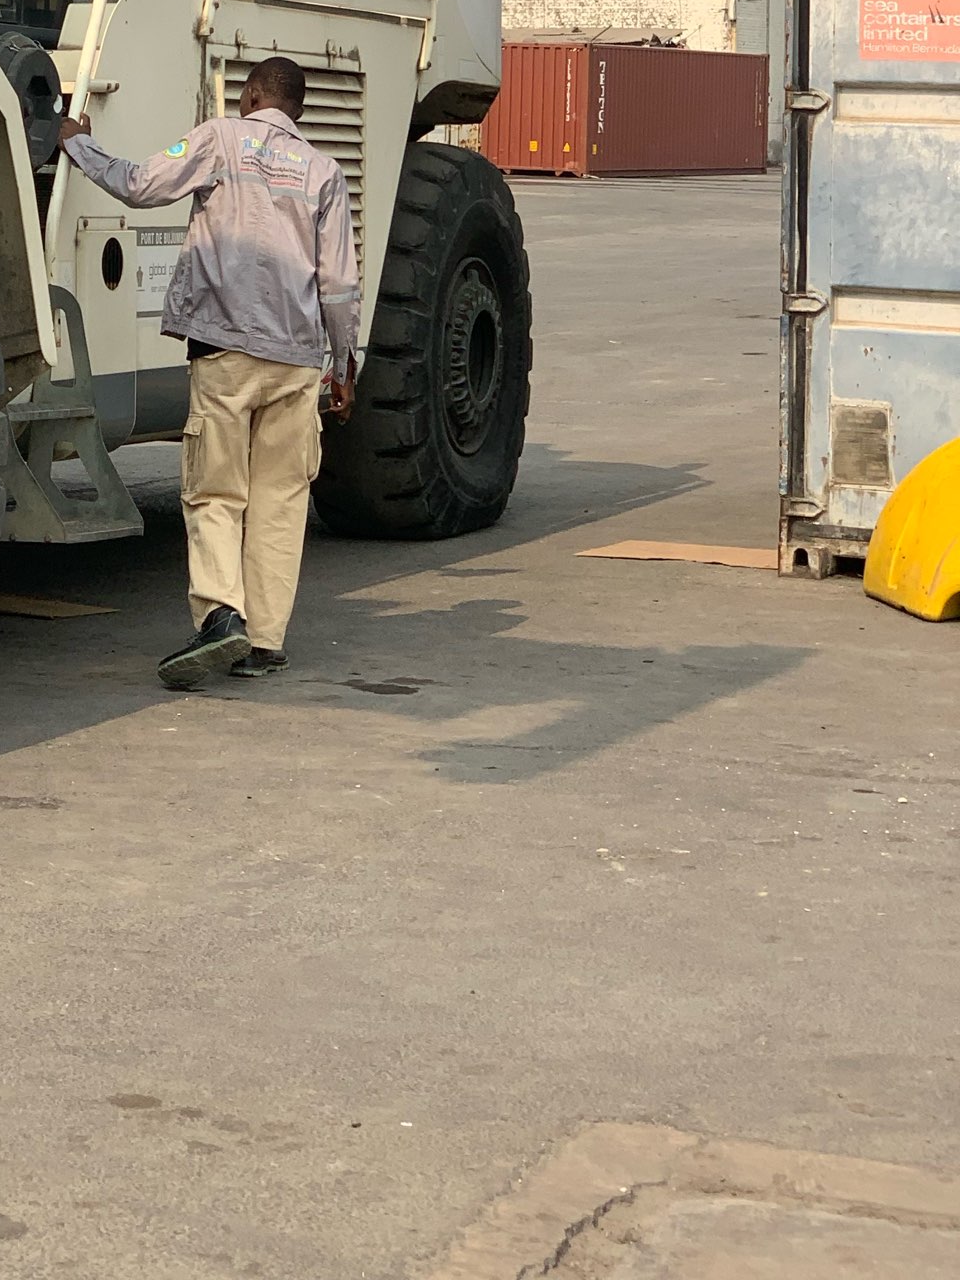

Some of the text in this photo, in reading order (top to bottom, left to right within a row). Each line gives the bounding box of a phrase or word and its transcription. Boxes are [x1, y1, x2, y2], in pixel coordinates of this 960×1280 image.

[864, 0, 898, 12] sea
[863, 24, 928, 41] limited
[141, 232, 155, 245] PORT
[156, 232, 163, 245] DE
